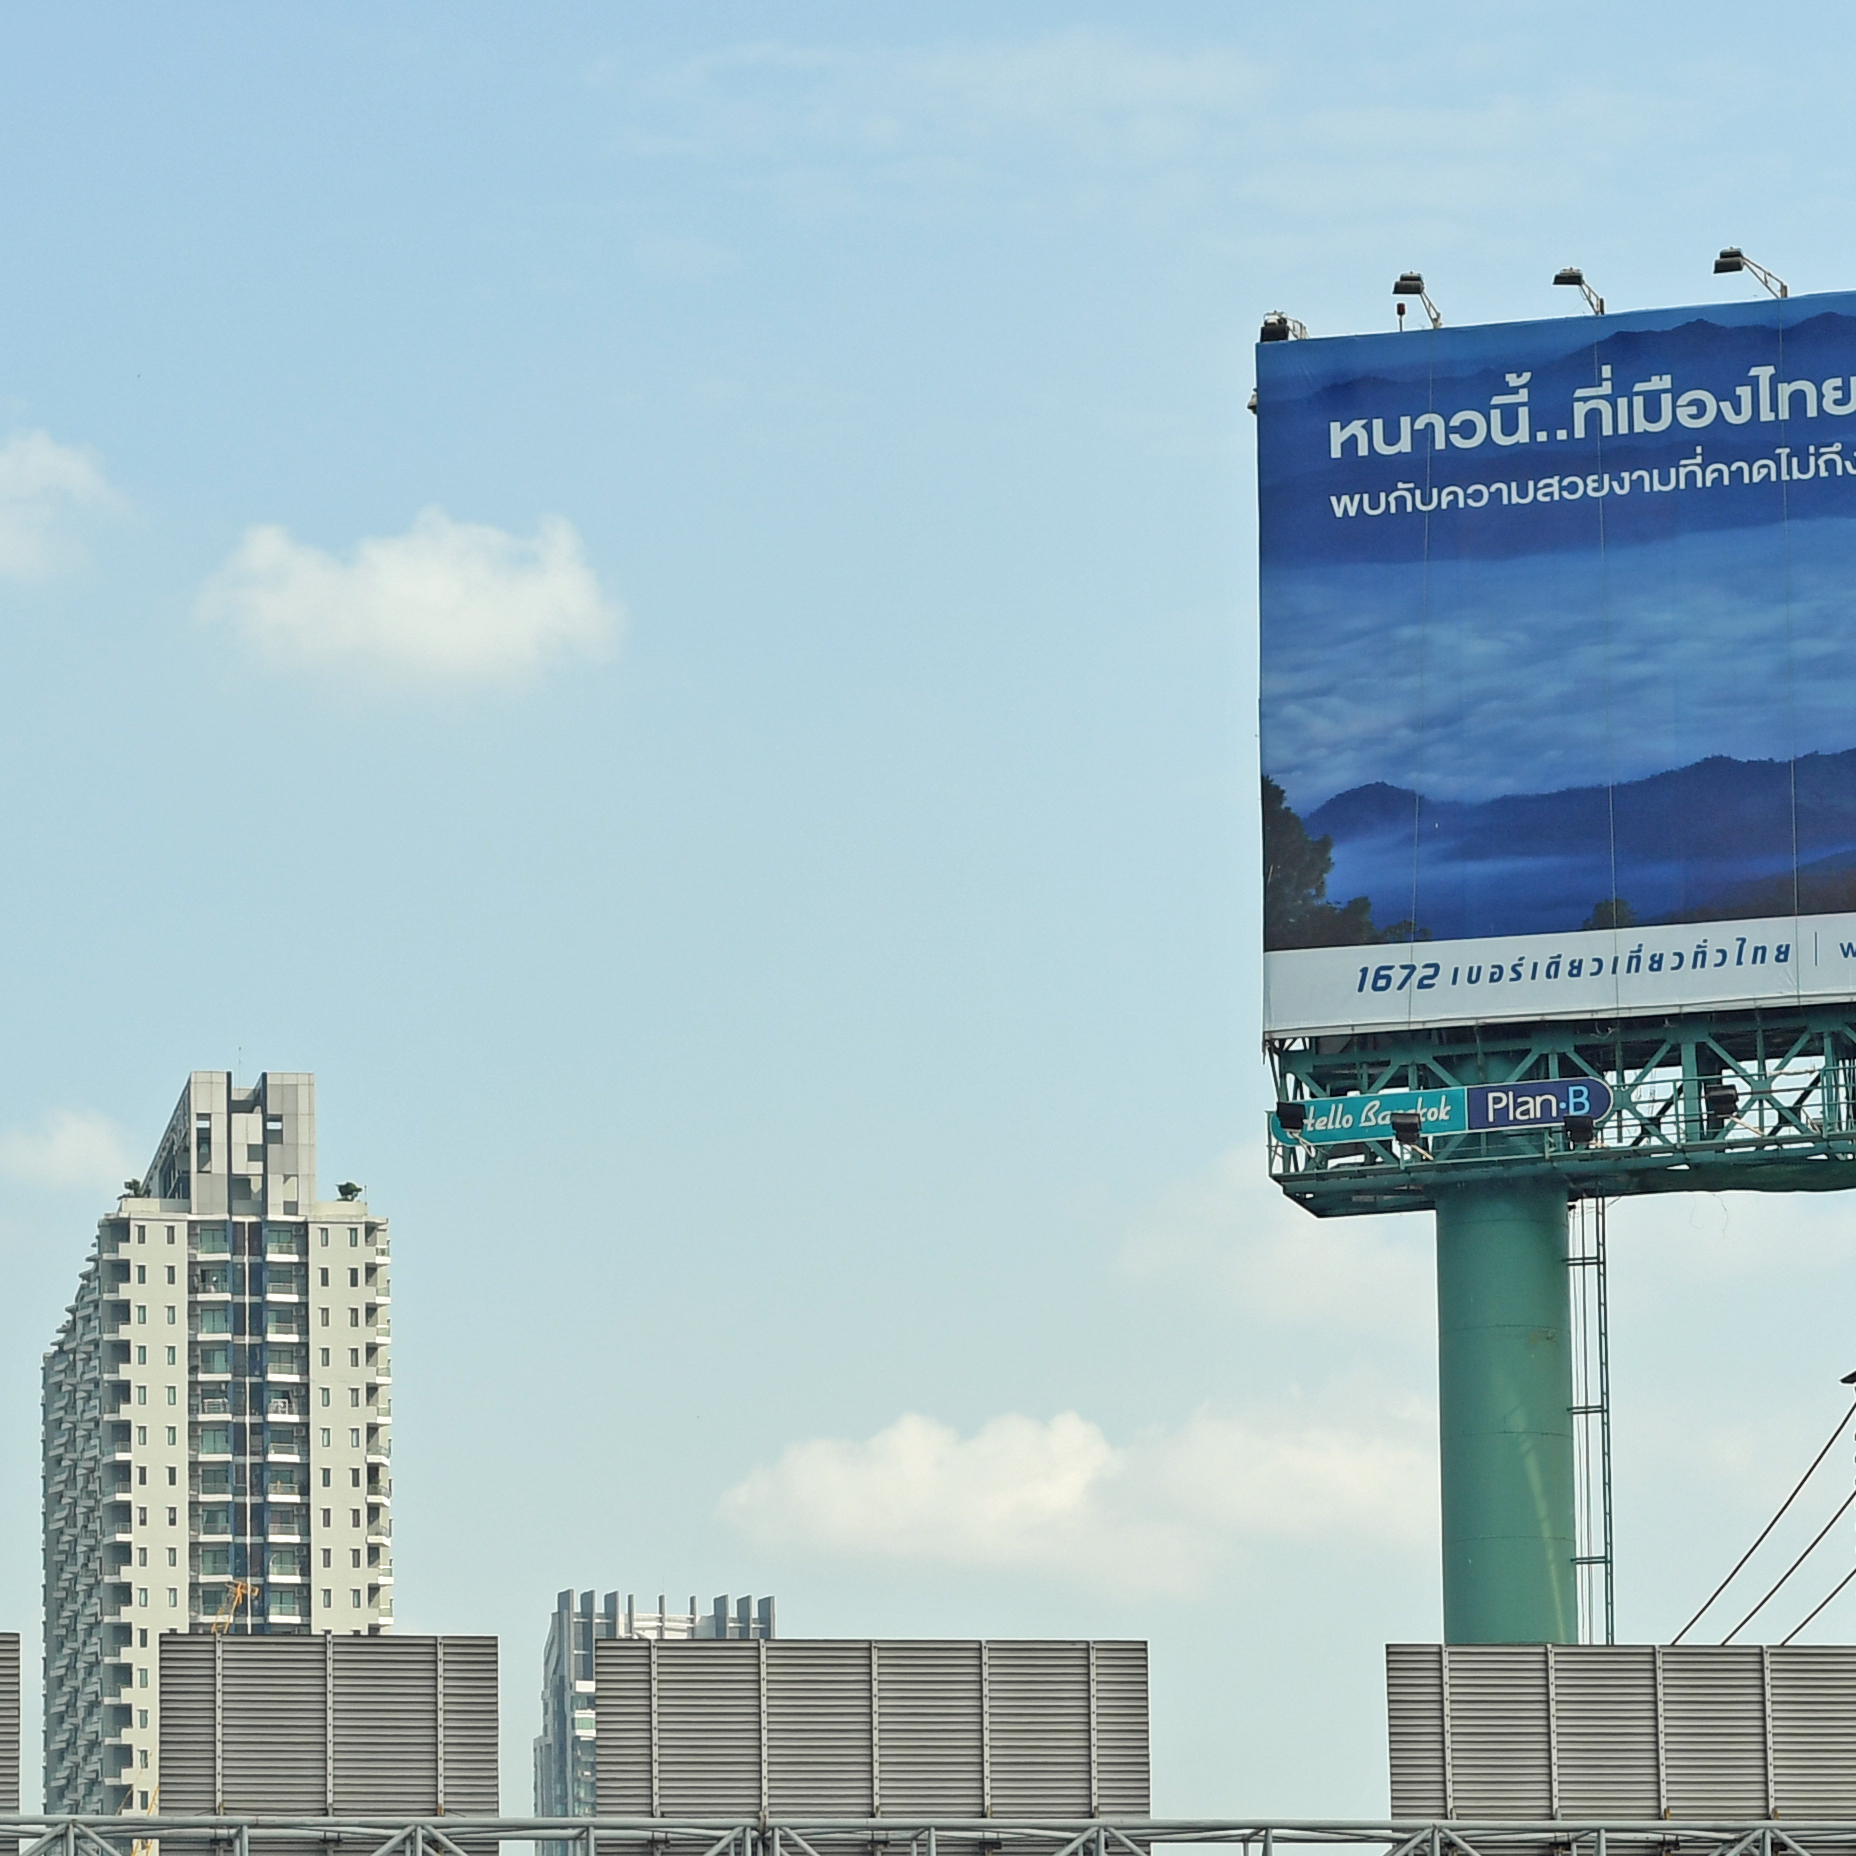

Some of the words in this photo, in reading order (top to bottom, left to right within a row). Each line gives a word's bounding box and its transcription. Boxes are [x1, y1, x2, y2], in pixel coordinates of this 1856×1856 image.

[1356, 961, 1442, 993] 1672
[1450, 936, 1793, 987] เบอร์เดียวเที่ยวทั่วไทย
